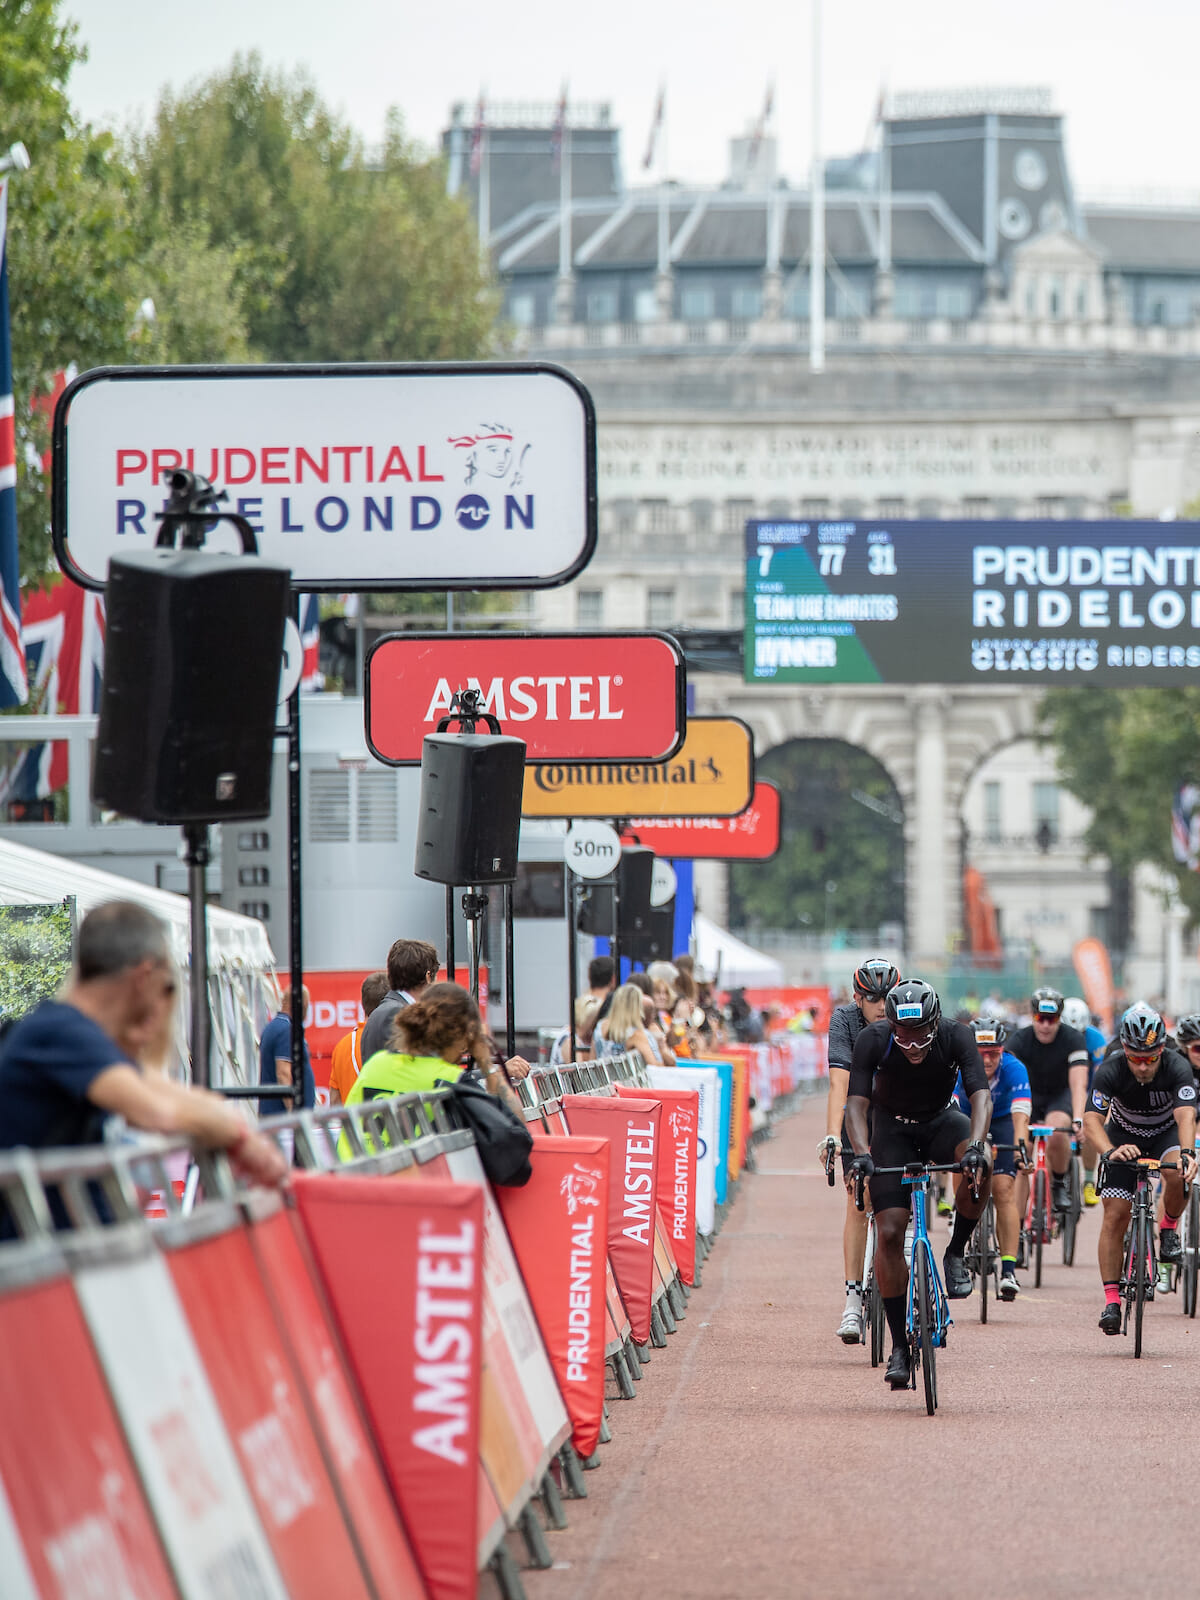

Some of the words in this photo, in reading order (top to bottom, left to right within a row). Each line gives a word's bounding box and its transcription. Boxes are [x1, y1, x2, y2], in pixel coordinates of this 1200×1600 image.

[115, 446, 445, 486] PRUDENTIAL
[757, 545, 774, 577] 7
[817, 544, 847, 576] 77
[868, 544, 897, 575] 31
[754, 636, 837, 668] WINNER
[972, 648, 1099, 671] CLASSIC
[572, 840, 614, 858] 50m
[622, 1120, 656, 1246] AMSTEL
[672, 1137, 690, 1240] PRUDENTIAL
[566, 1215, 595, 1382] PRUDENTIAL
[411, 1219, 476, 1466] AMSTEL
